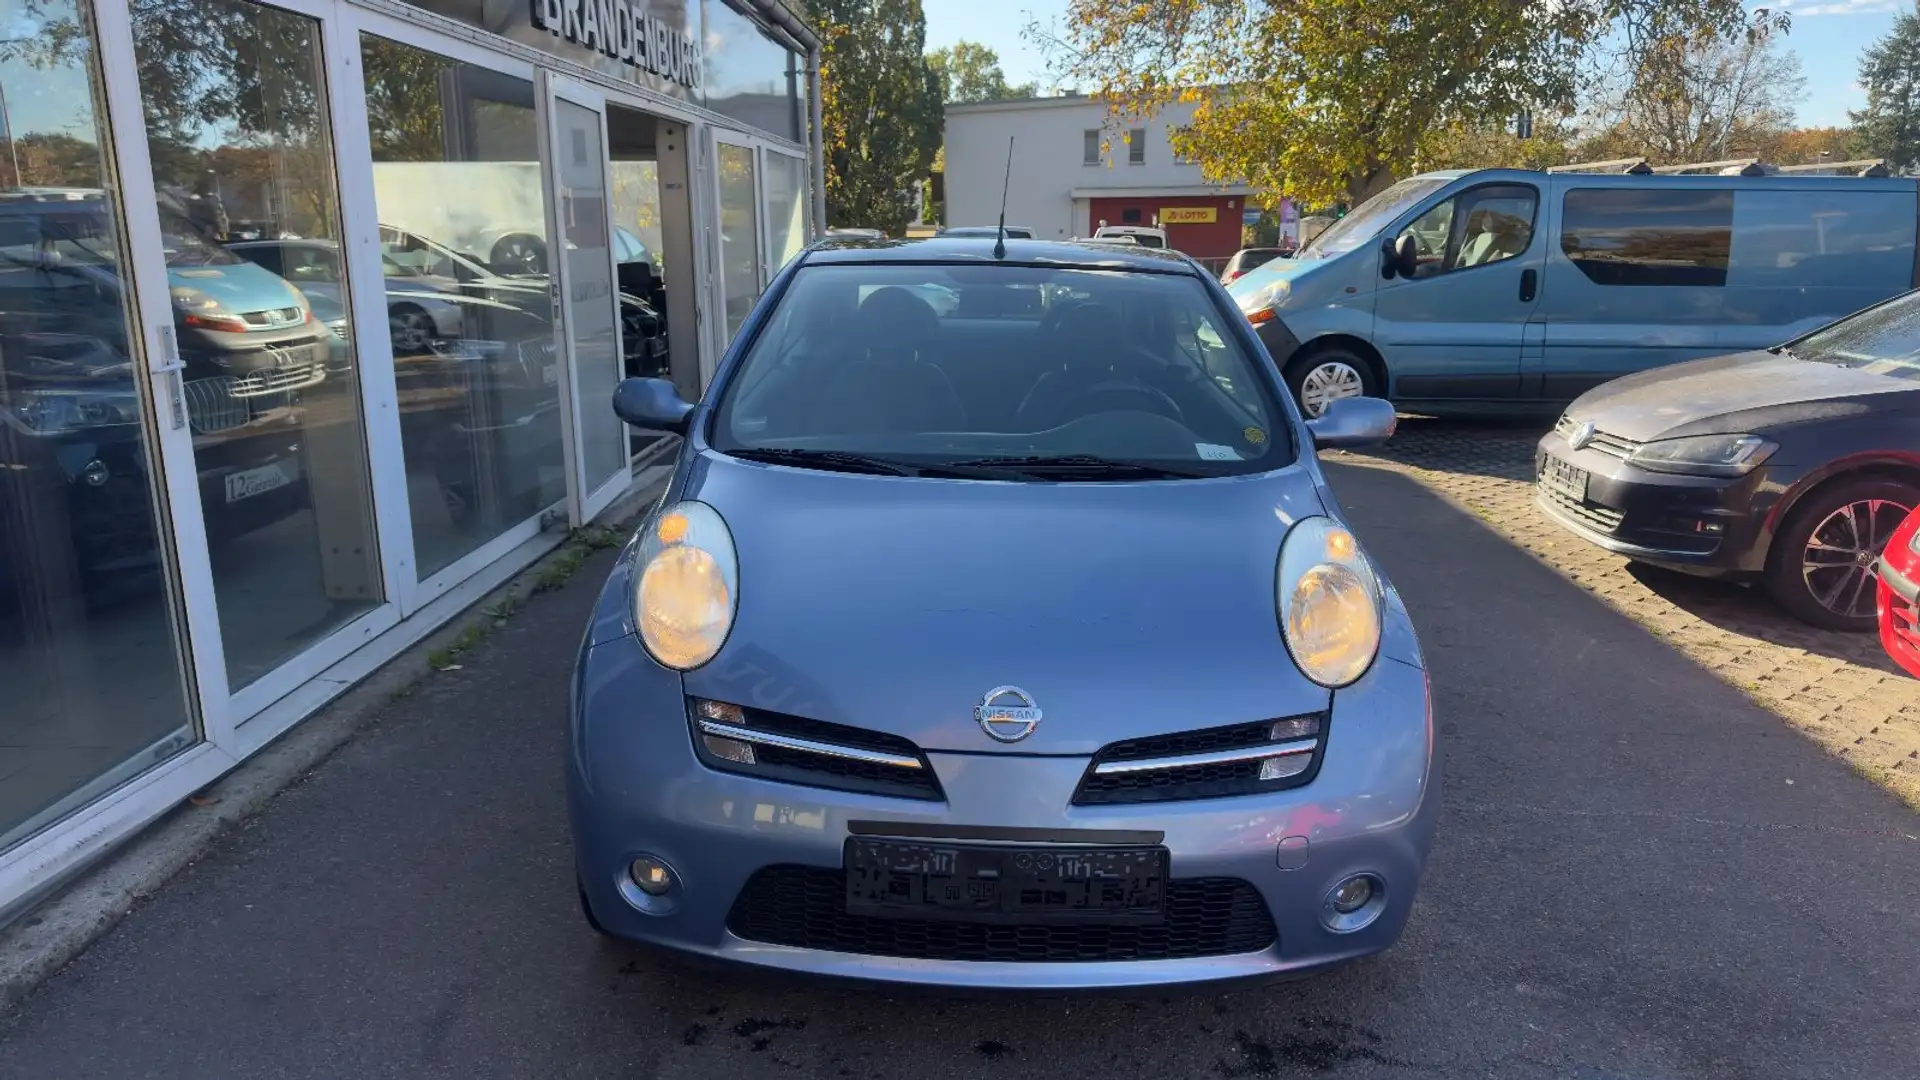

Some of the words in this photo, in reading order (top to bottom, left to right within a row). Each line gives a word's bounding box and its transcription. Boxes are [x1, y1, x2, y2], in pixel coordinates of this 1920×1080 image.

[1180, 211, 1208, 220] LOTTO
[229, 475, 246, 500] 12
[982, 708, 1035, 719] NISSAN
